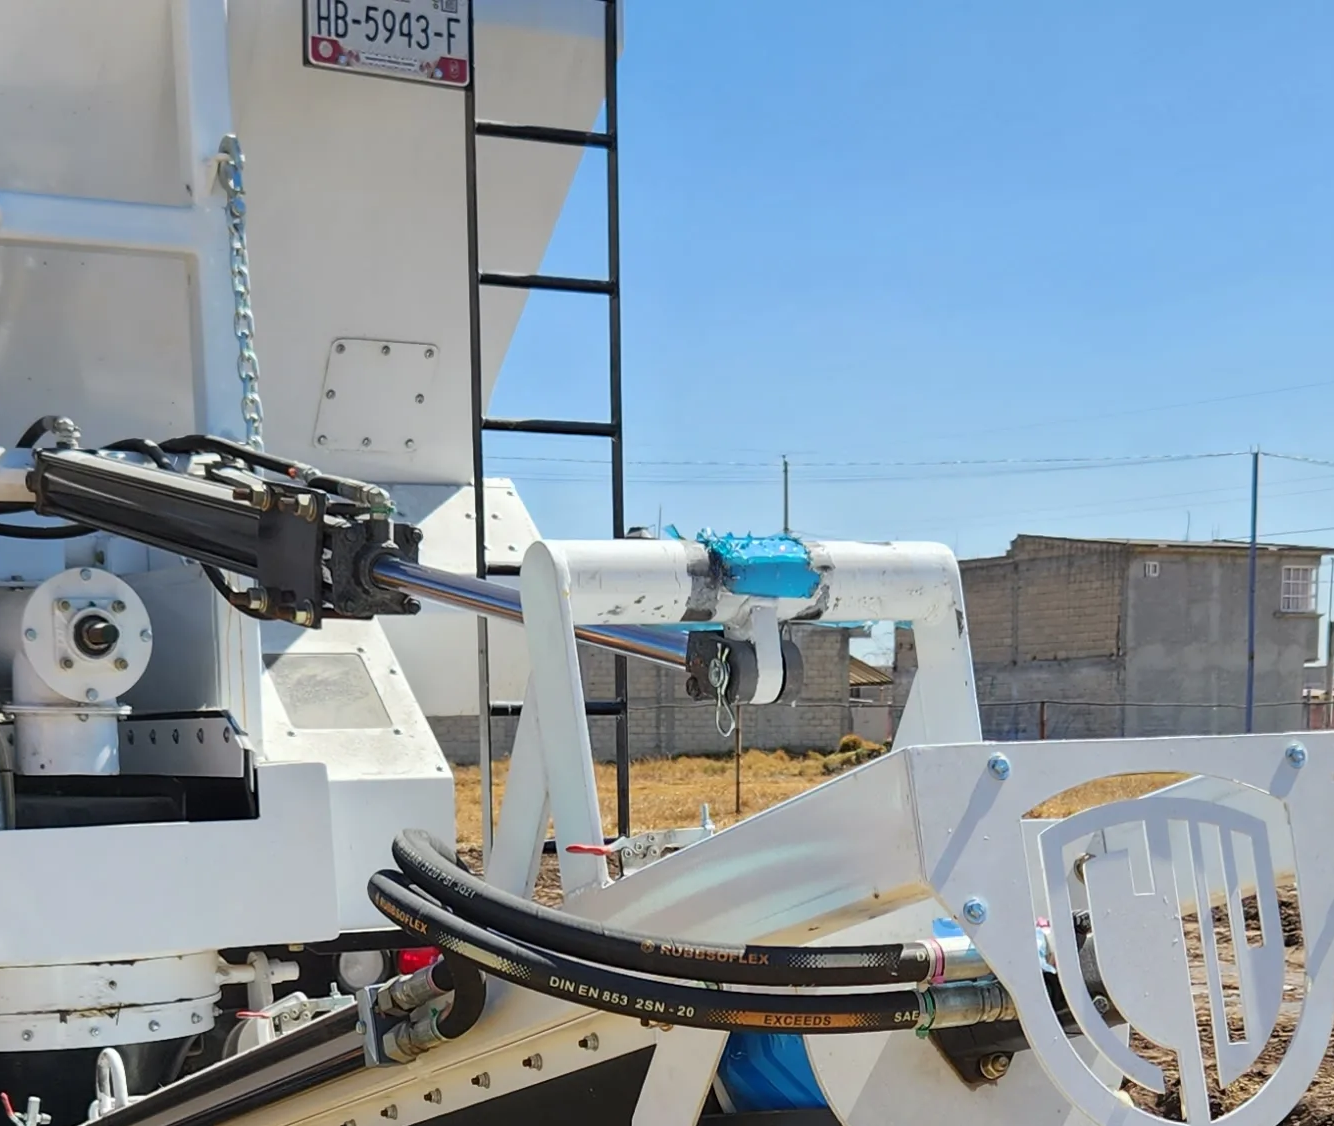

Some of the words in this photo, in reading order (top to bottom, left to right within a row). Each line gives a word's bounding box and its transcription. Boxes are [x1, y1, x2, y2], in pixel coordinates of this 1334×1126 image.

[317, 0, 461, 55] HB-5943-F
[660, 943, 769, 966] RUBBSOFLEX
[549, 975, 575, 993] DIN
[578, 985, 599, 1000] EN
[602, 990, 628, 1006] 853
[634, 998, 665, 1014] 2SN
[677, 1005, 695, 1018] 20
[763, 1014, 832, 1027] EXCEEDS
[893, 1010, 919, 1023] SAE
